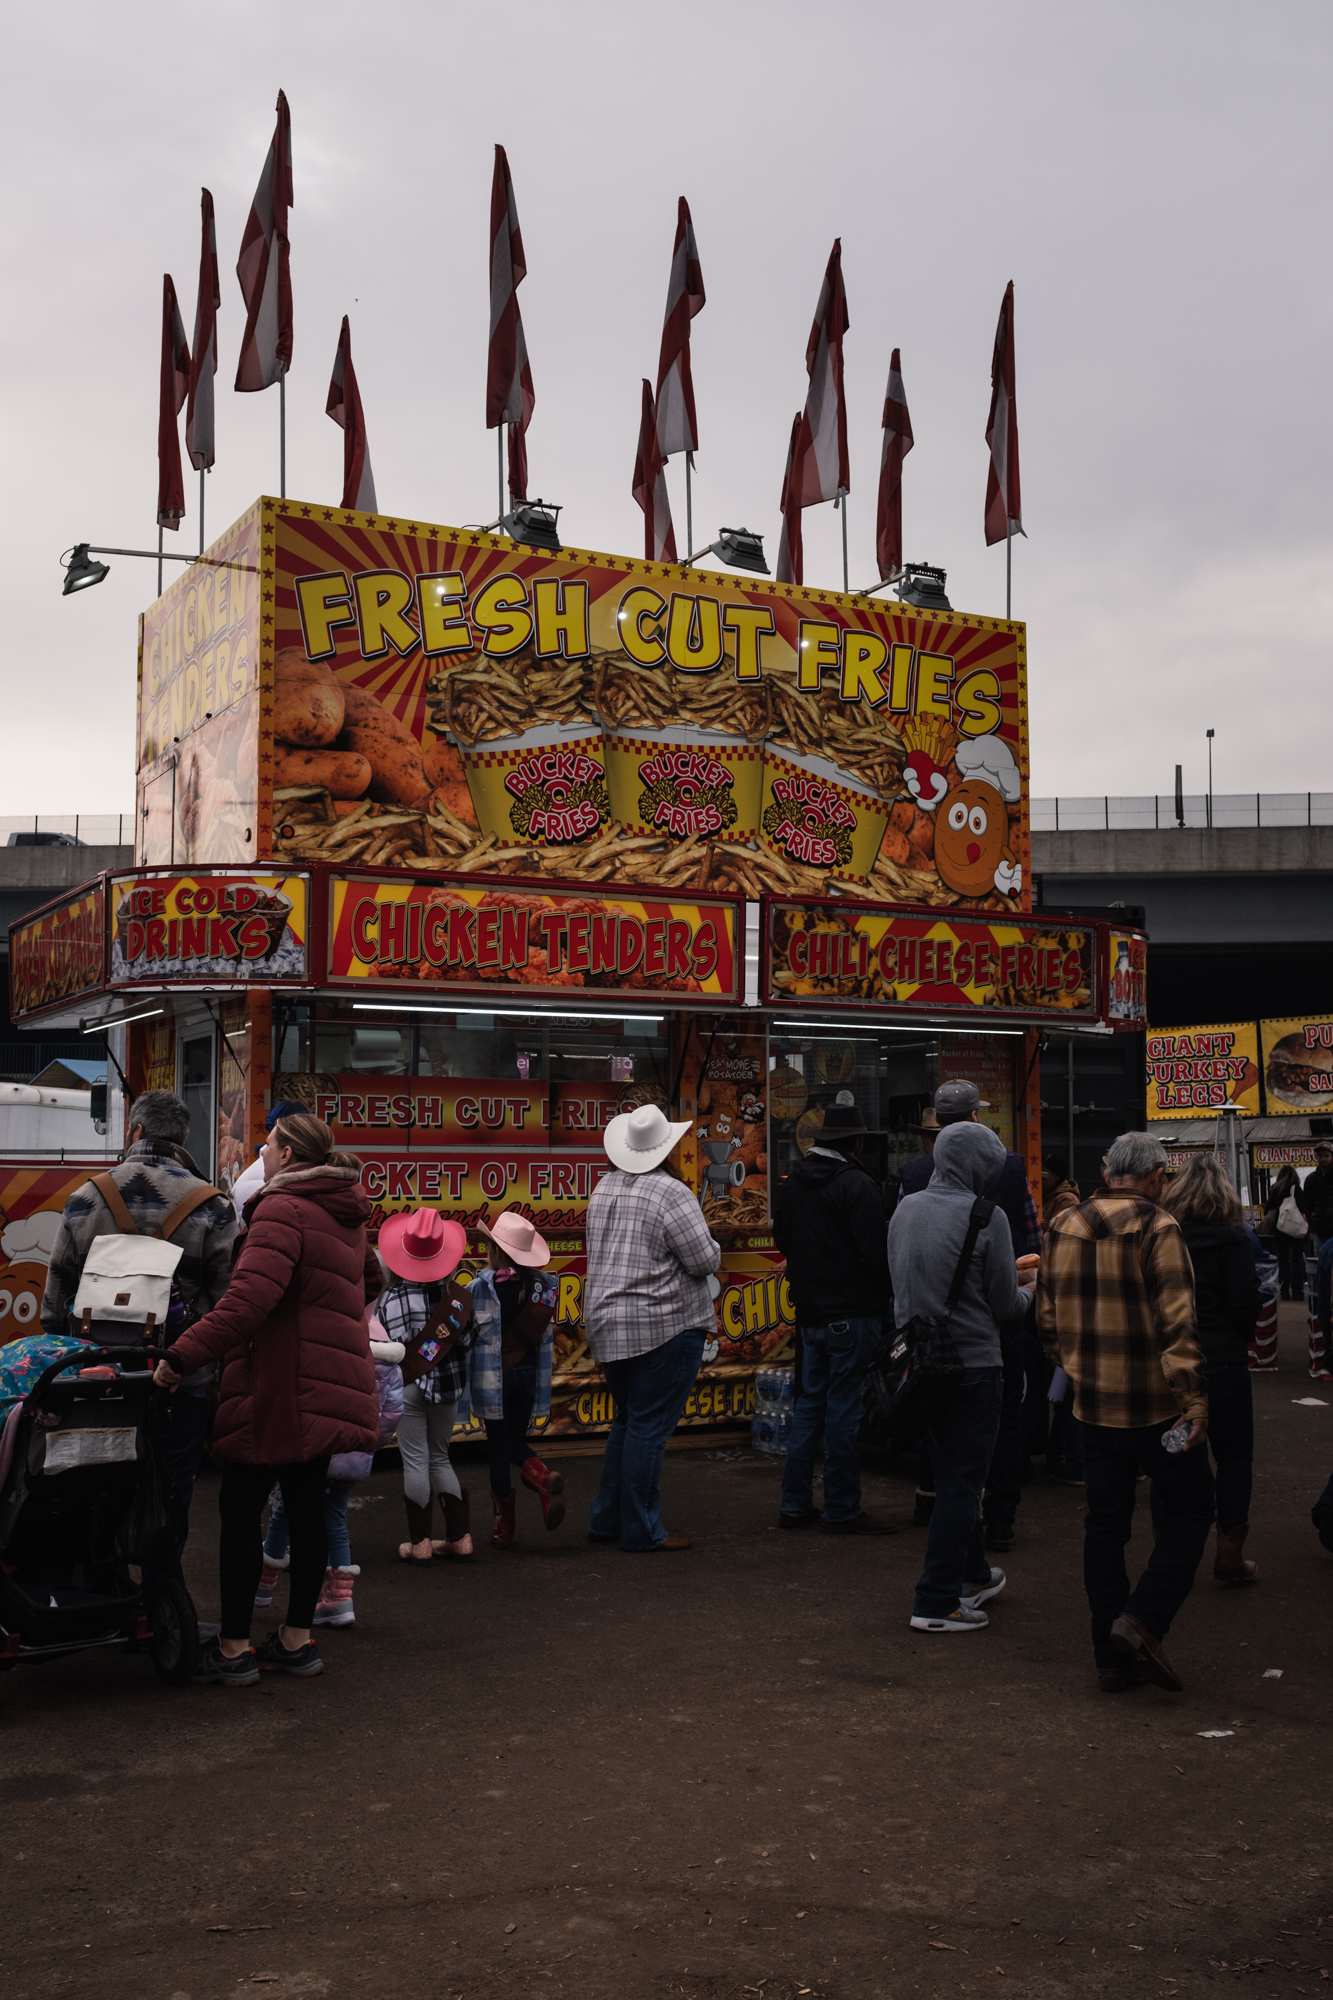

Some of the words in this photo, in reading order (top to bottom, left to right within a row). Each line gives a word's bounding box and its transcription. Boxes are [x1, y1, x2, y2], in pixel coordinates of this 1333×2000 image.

[294, 568, 590, 662] FRESH
[617, 584, 776, 681] CUT
[798, 618, 1003, 738] FRIES
[505, 752, 605, 797] BUCKET
[639, 751, 734, 788] BUCKET
[529, 801, 600, 840] FRIES
[654, 801, 722, 835] FRIES
[772, 778, 857, 831] BUCKET
[776, 820, 837, 864] FRIES
[129, 889, 166, 914] ICE
[174, 887, 258, 914] COLD
[126, 915, 271, 961] DRINKS
[352, 896, 530, 970] CHICKEN
[541, 911, 720, 980] TENDERS
[787, 928, 870, 978] CHILI
[878, 934, 991, 988] CHEESE
[999, 943, 1083, 993] FRIES
[1147, 1032, 1235, 1059] GIANT
[315, 1093, 442, 1127] FRESH
[455, 1098, 530, 1128] CUT
[1157, 1083, 1227, 1109] LEGS
[359, 1160, 467, 1200] CKET
[480, 1161, 518, 1200] O'
[529, 1162, 609, 1200] FRIE
[547, 1240, 583, 1252] HEESE
[721, 1272, 799, 1340] CHIC
[575, 1390, 617, 1426] CHI
